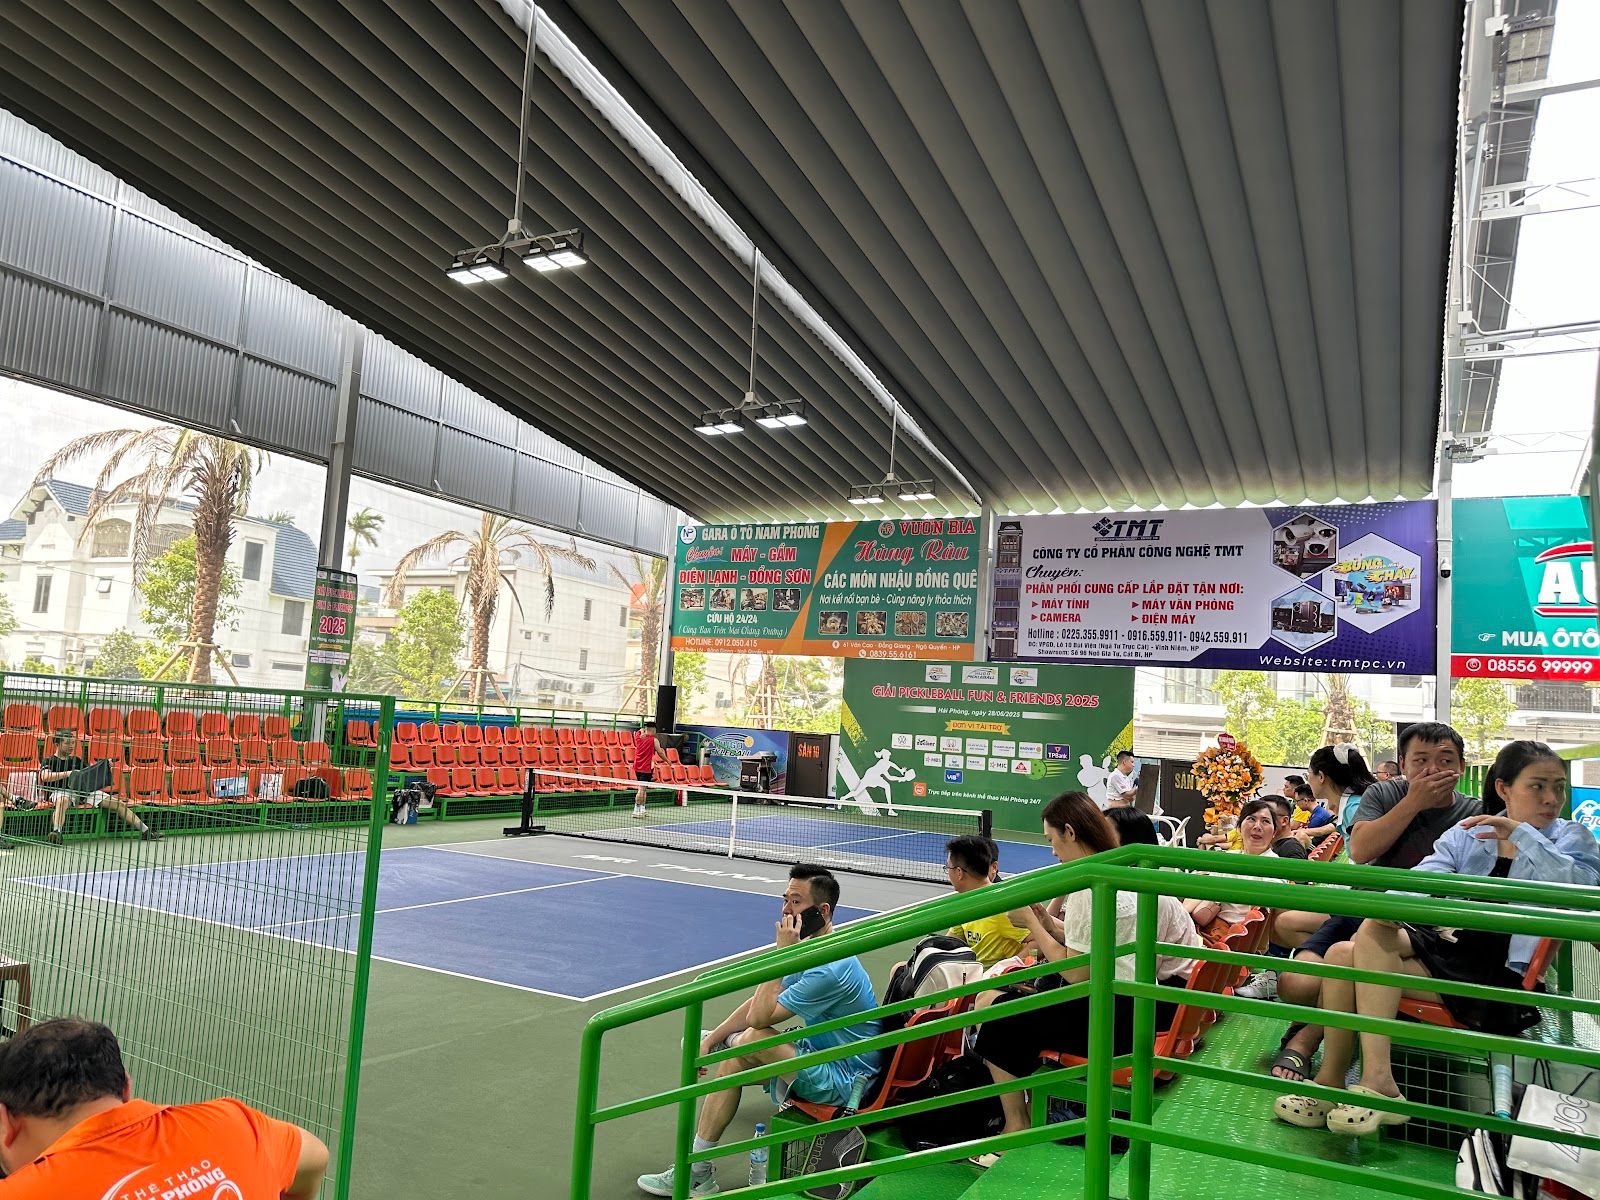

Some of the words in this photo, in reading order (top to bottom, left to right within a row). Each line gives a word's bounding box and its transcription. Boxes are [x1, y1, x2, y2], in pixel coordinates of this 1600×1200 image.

[702, 528, 728, 540] GARA
[730, 525, 738, 540] Ô
[740, 525, 753, 540] TÔ
[756, 526, 780, 540] NAM
[782, 525, 820, 539] PHONG
[948, 519, 976, 534] BIA
[1112, 519, 1164, 537] TMT
[731, 545, 758, 562] MÁY
[854, 539, 914, 566] Hùng
[921, 539, 970, 560] Râu
[1032, 546, 1062, 559] CÔNG
[1066, 547, 1079, 559] TY
[1084, 544, 1098, 558] CỔ
[1102, 544, 1135, 558] PHẦN
[1139, 545, 1171, 558] CÔNG
[1176, 544, 1210, 559] NGHỆ
[1214, 546, 1244, 556] TMT
[678, 568, 705, 587] ĐIỆN
[708, 570, 738, 587] LẠNH
[748, 565, 782, 584] ĐỒNG
[785, 568, 812, 584] SƠN
[824, 570, 846, 588] CÁC
[850, 570, 876, 588] MÓN
[880, 570, 912, 591] NHẬU
[916, 567, 948, 588] ĐỒNG
[952, 570, 977, 590] QUÊ
[1026, 564, 1084, 582] Chuyên:
[1026, 582, 1053, 594] PHÂN
[1057, 580, 1080, 594] PHỐI
[1084, 584, 1114, 594] CUNG
[1118, 580, 1139, 594] CẤP
[1143, 580, 1164, 594] LẮP
[1168, 581, 1189, 596] ĐẶT
[1193, 582, 1216, 596] TẬN
[1220, 582, 1244, 594] NƠI:
[832, 592, 842, 604] kết
[844, 592, 854, 604] nối
[856, 594, 868, 606] bạn
[870, 594, 880, 604] bè
[886, 594, 905, 606] Cùng
[907, 595, 924, 606] nâng
[927, 594, 932, 606] ly
[934, 594, 952, 604] thỏa
[952, 594, 972, 605] thích
[1042, 598, 1064, 608] MÁY
[1066, 598, 1090, 608] TÍNH
[1142, 598, 1166, 610] MÁY
[1170, 598, 1192, 610] VĂN
[1196, 598, 1234, 610] PHÒNG
[706, 614, 722, 624] CỨU
[724, 614, 734, 625] HỘ
[736, 614, 758, 624] 24/24
[1040, 613, 1082, 622] CAMERA
[1142, 612, 1168, 626] ĐIỆN
[1172, 612, 1196, 624] MÁY
[319, 616, 346, 636] 2025
[686, 638, 714, 646] HOTLINE:
[715, 638, 758, 648] 0912.050.415
[1028, 628, 1054, 639] Hotline
[1062, 628, 1118, 640] 0225.355.9911
[1190, 631, 1248, 643] 0942.559.911
[1502, 630, 1549, 648] MUA
[1552, 627, 1600, 648] ÔTÔ
[1487, 659, 1537, 672] 08556
[1542, 660, 1593, 674] 99999
[872, 682, 896, 698] GIẢI
[898, 687, 964, 700] PICKLEBALL
[968, 689, 994, 702] FUN
[996, 691, 1006, 704] &
[1009, 692, 1062, 706] FRIENDS
[1064, 694, 1100, 708] 2025
[798, 742, 812, 759] SÂN
[812, 744, 820, 758] 10
[1174, 771, 1194, 790] SÂN
[164, 1160, 212, 1187] THAO
